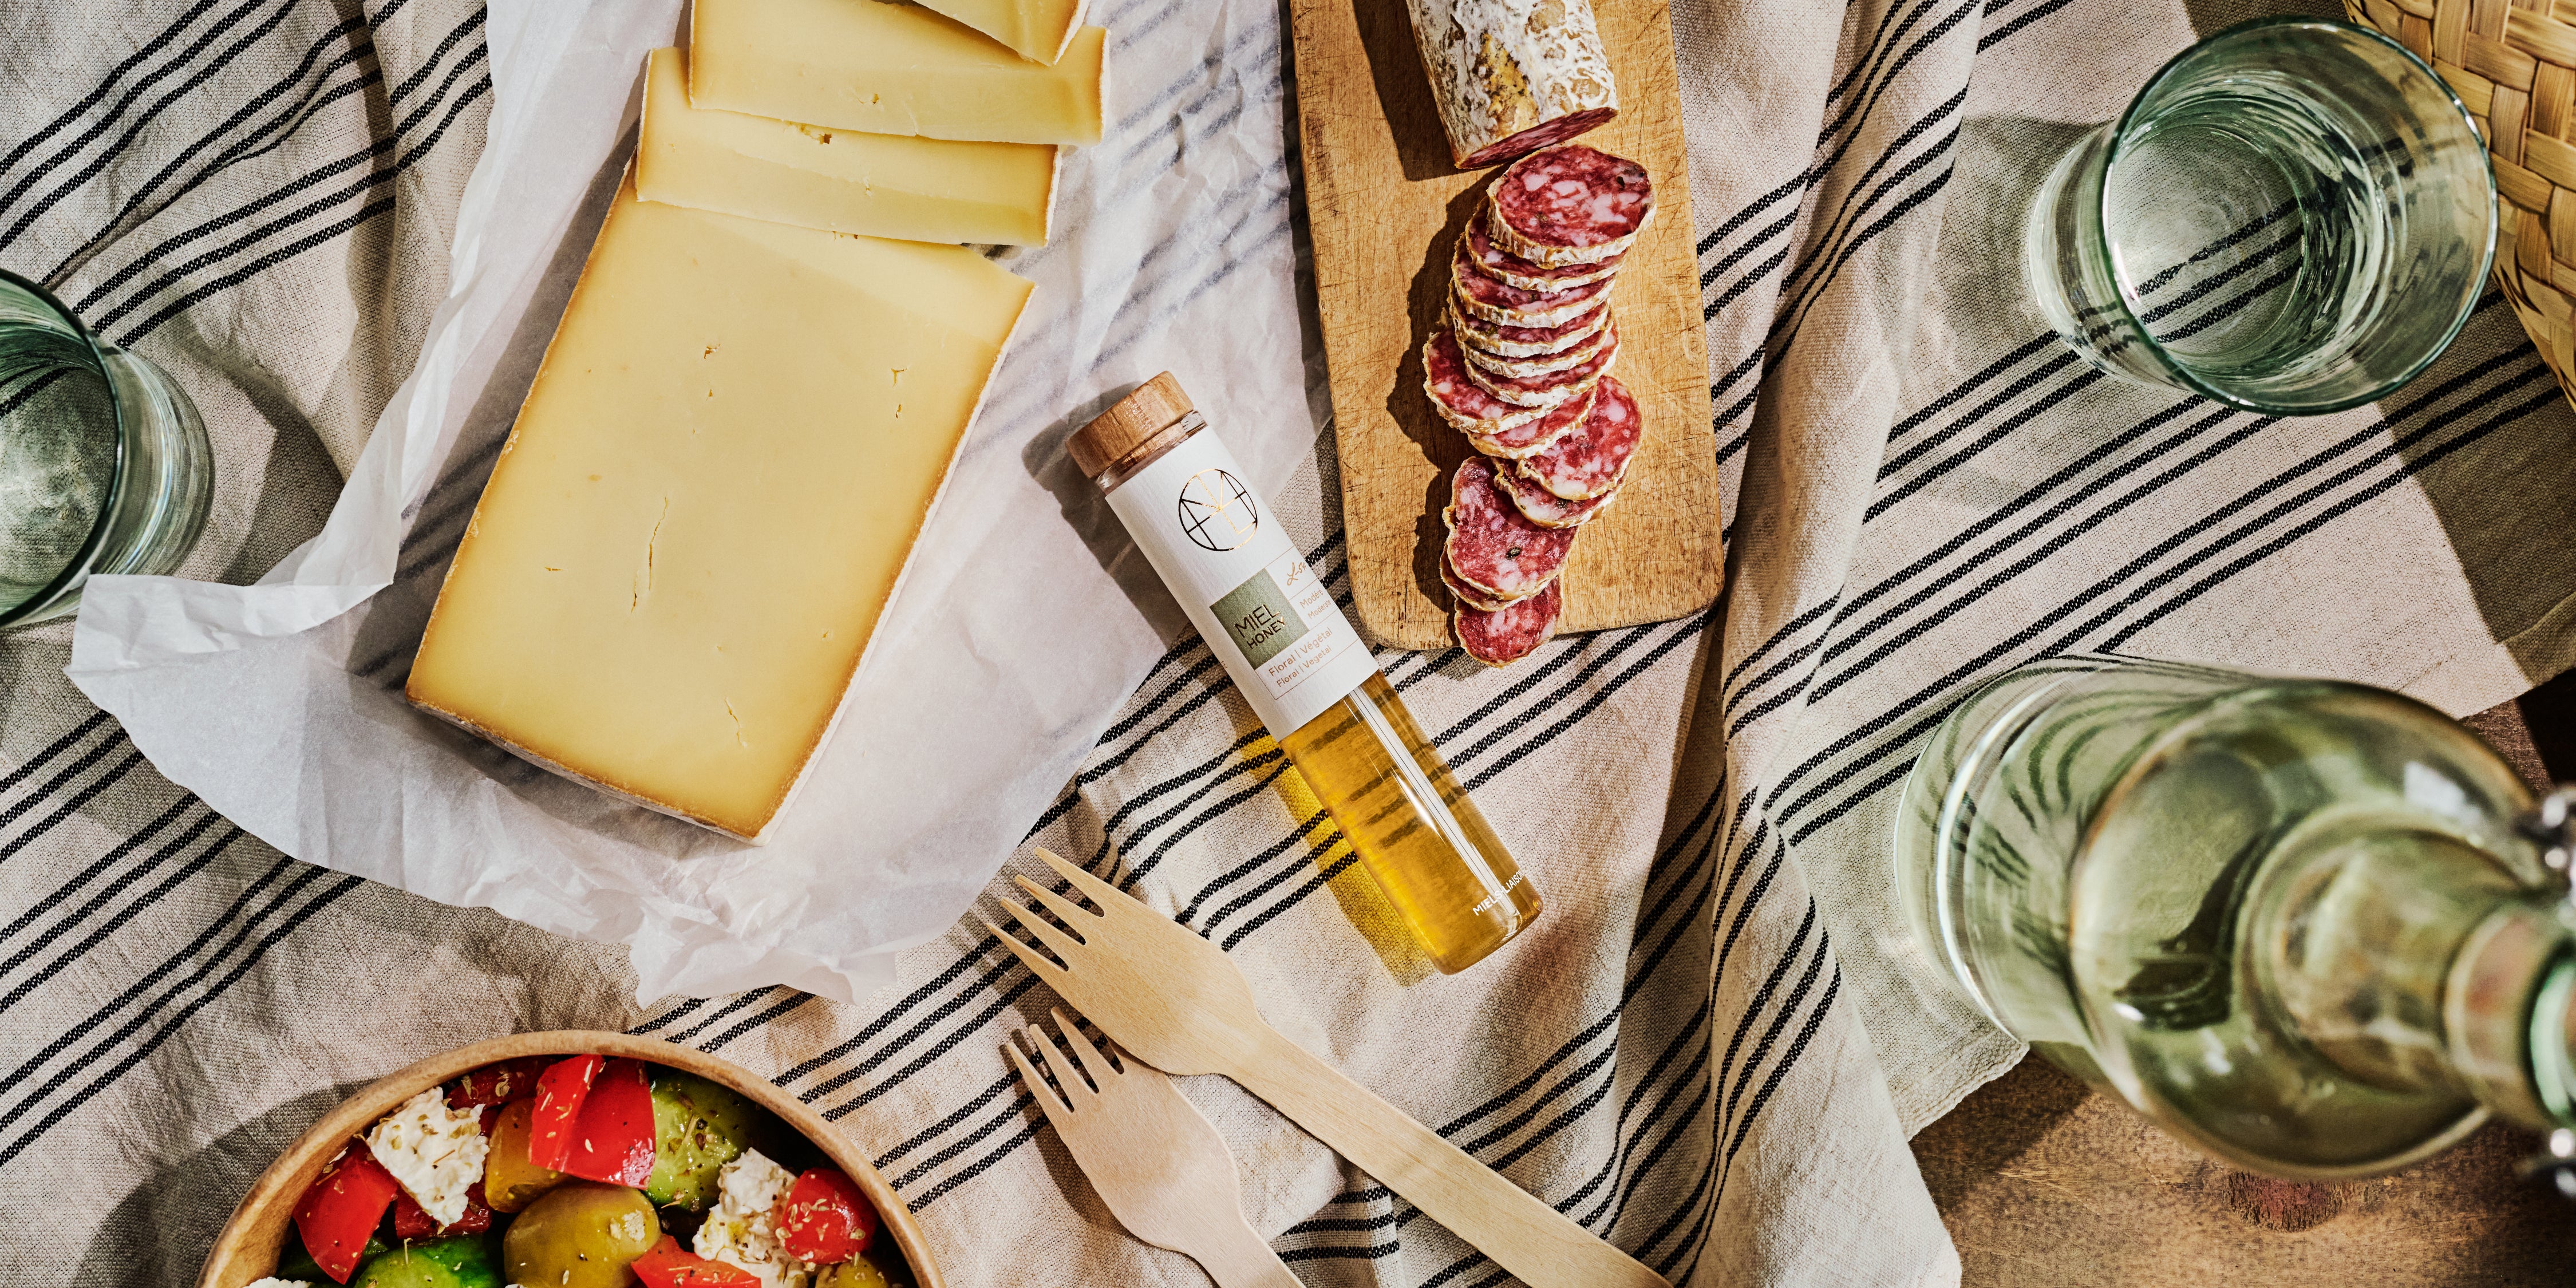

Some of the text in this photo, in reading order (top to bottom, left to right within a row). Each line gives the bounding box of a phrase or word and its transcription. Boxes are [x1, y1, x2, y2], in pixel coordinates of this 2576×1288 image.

[1299, 589, 1323, 609] Modéré
[1307, 599, 1332, 619] Moderate
[1235, 604, 1280, 638] MIEL
[1247, 616, 1285, 649] HONEY
[1269, 654, 1296, 677] Floral
[1300, 627, 1333, 653] Végétal
[1276, 669, 1299, 687] Floral
[1302, 645, 1332, 668] Vegetal
